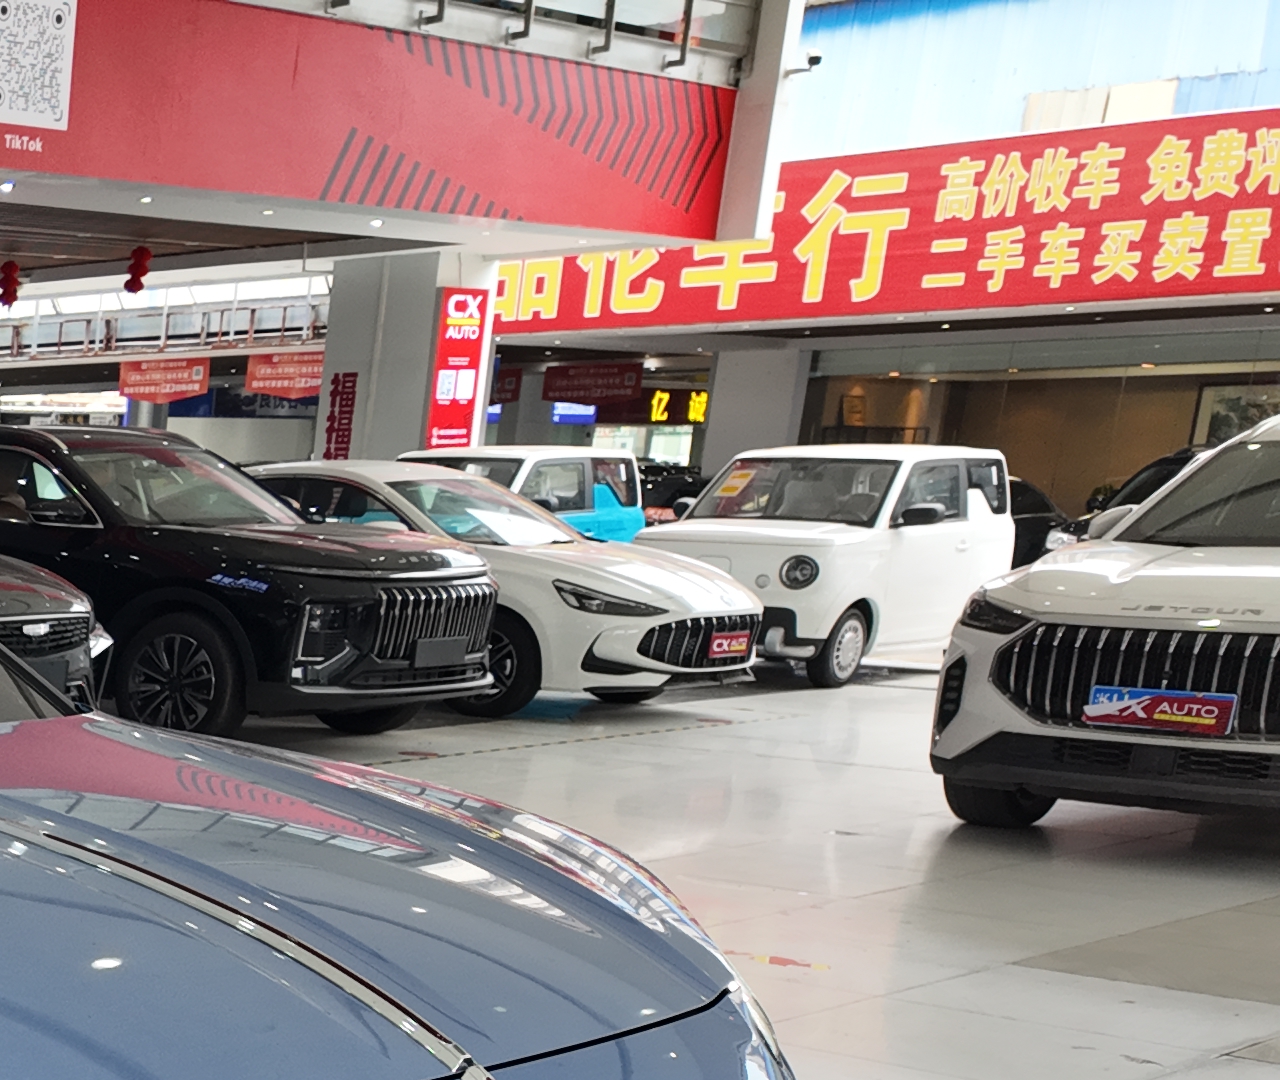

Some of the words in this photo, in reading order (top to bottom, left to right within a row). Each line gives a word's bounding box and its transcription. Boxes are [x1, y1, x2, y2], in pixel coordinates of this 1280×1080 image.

[4, 133, 44, 152] TikTok
[934, 142, 1127, 223] 高价收车
[920, 208, 1273, 293] 二手车买卖置
[447, 294, 484, 319] CX
[445, 326, 480, 340] AUTO
[1120, 604, 1265, 616] JETOUR
[712, 638, 731, 652] CX
[1155, 701, 1219, 718] AUTO
